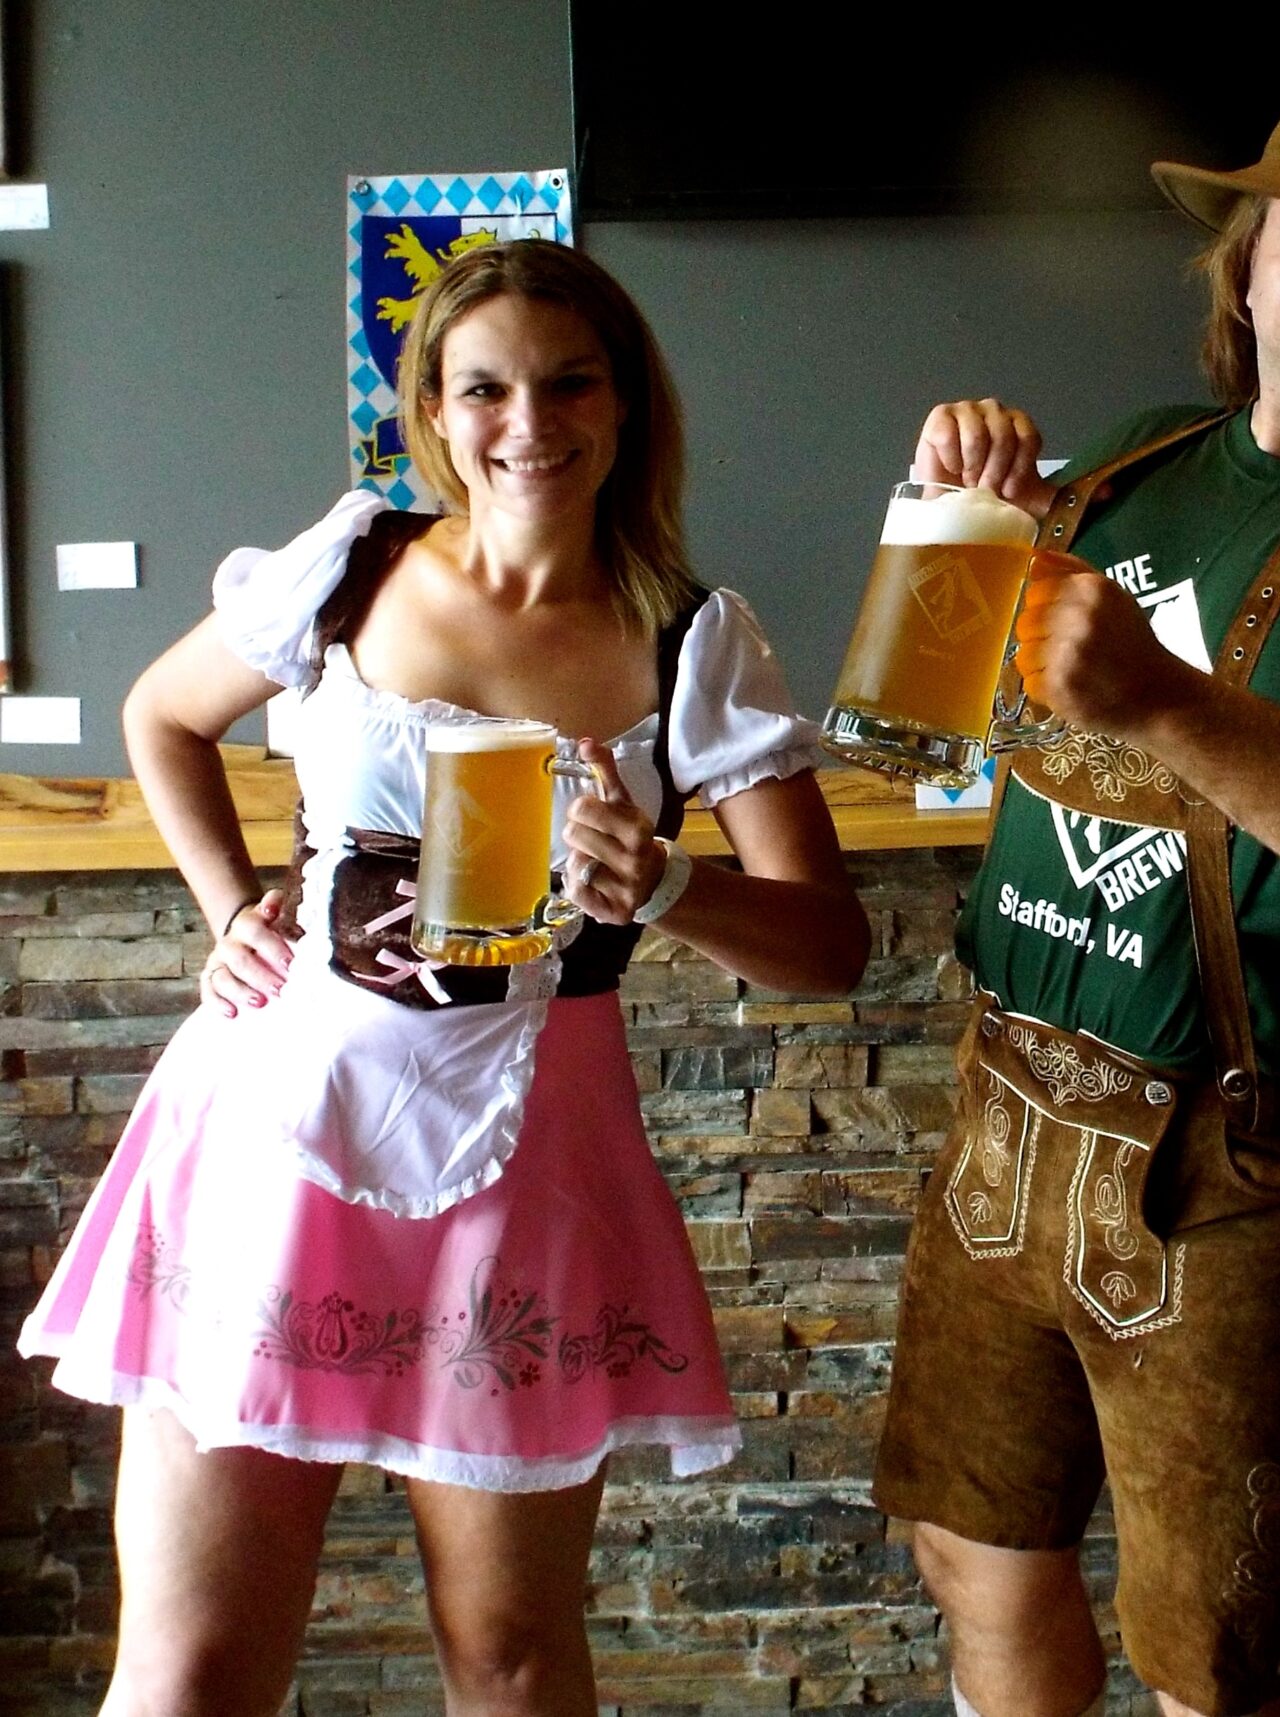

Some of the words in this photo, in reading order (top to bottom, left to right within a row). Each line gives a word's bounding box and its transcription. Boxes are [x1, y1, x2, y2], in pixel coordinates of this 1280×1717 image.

[1105, 553, 1158, 595] RE
[998, 883, 1096, 954] Stafford,
[1106, 923, 1143, 969] VA
